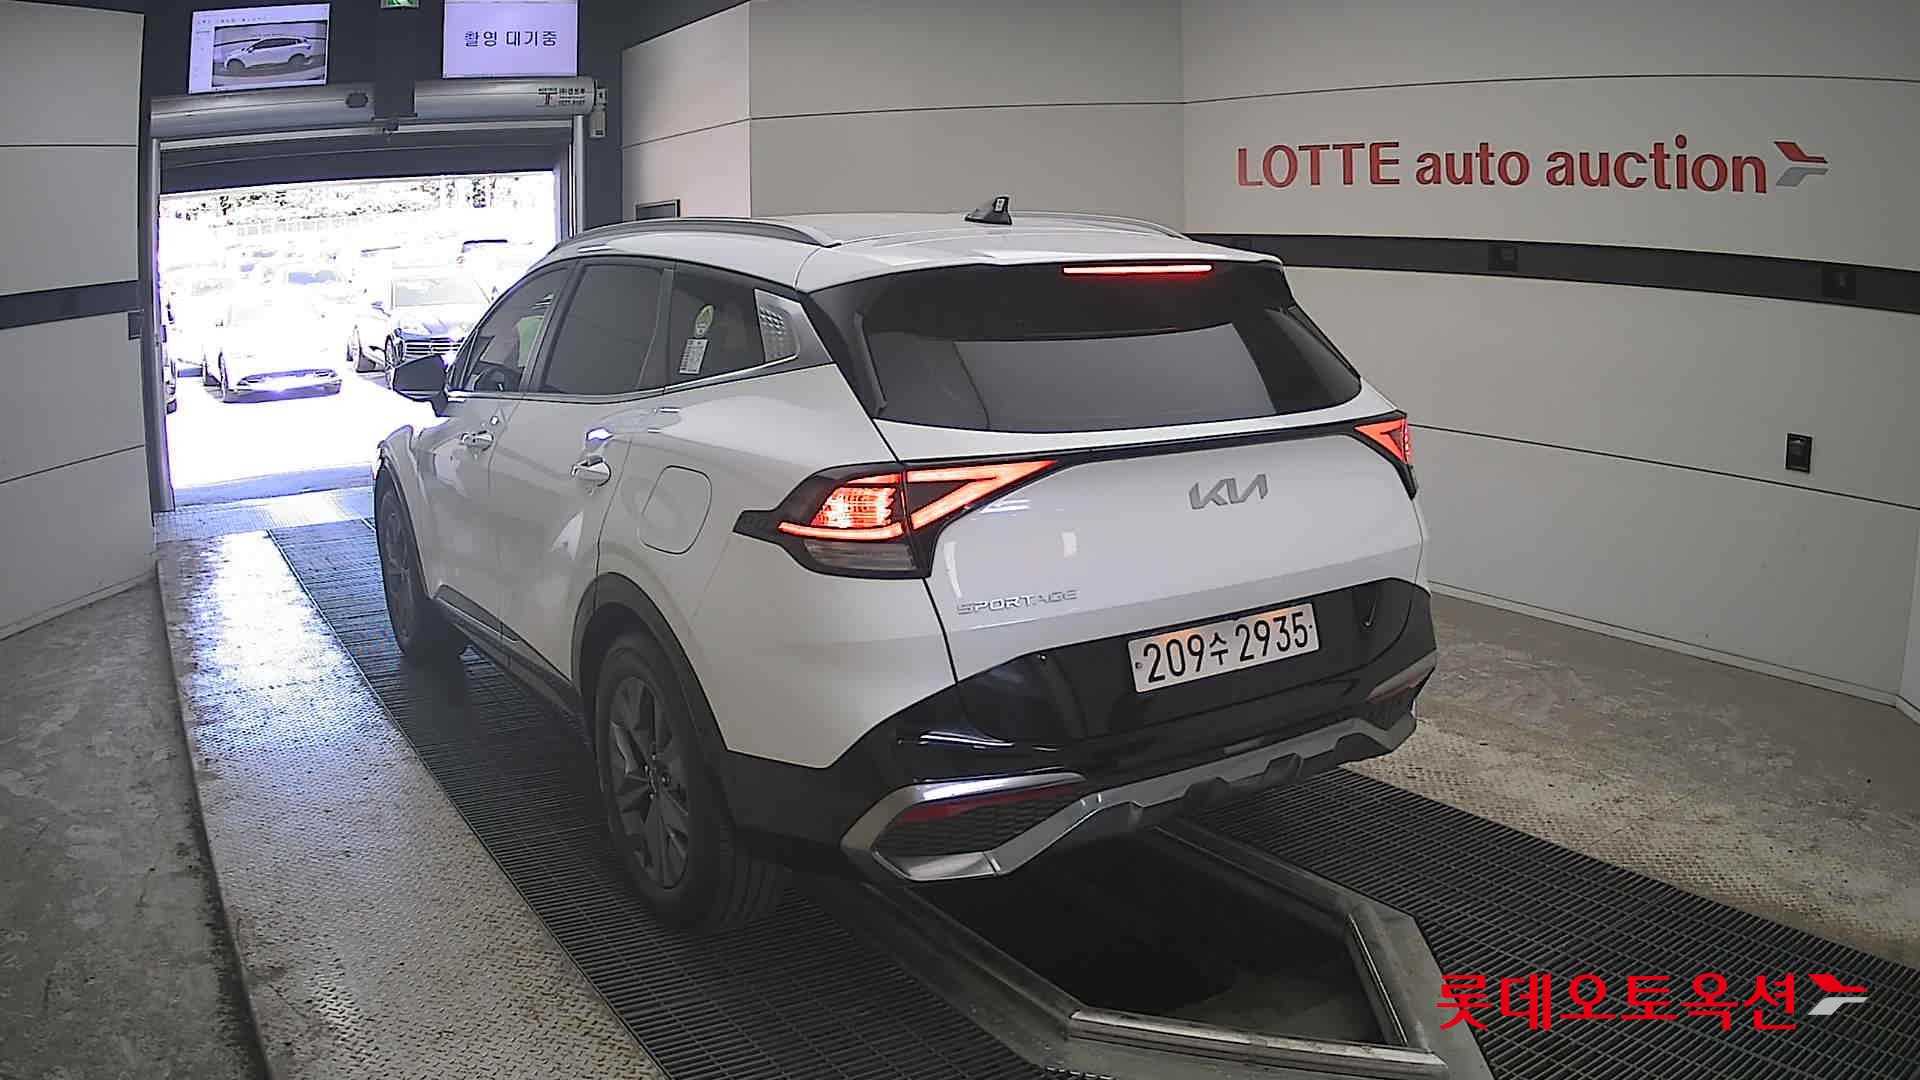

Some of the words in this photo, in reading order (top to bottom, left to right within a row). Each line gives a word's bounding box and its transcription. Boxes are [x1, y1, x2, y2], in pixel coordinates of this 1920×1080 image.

[505, 30, 558, 47] 대기중
[1236, 141, 1400, 187] LOTTE
[1415, 141, 1531, 187] auto
[1545, 133, 1768, 194] auction
[957, 589, 1078, 616] SPORTAGE
[1143, 632, 1229, 683] 209수
[1234, 611, 1308, 662] 2935
